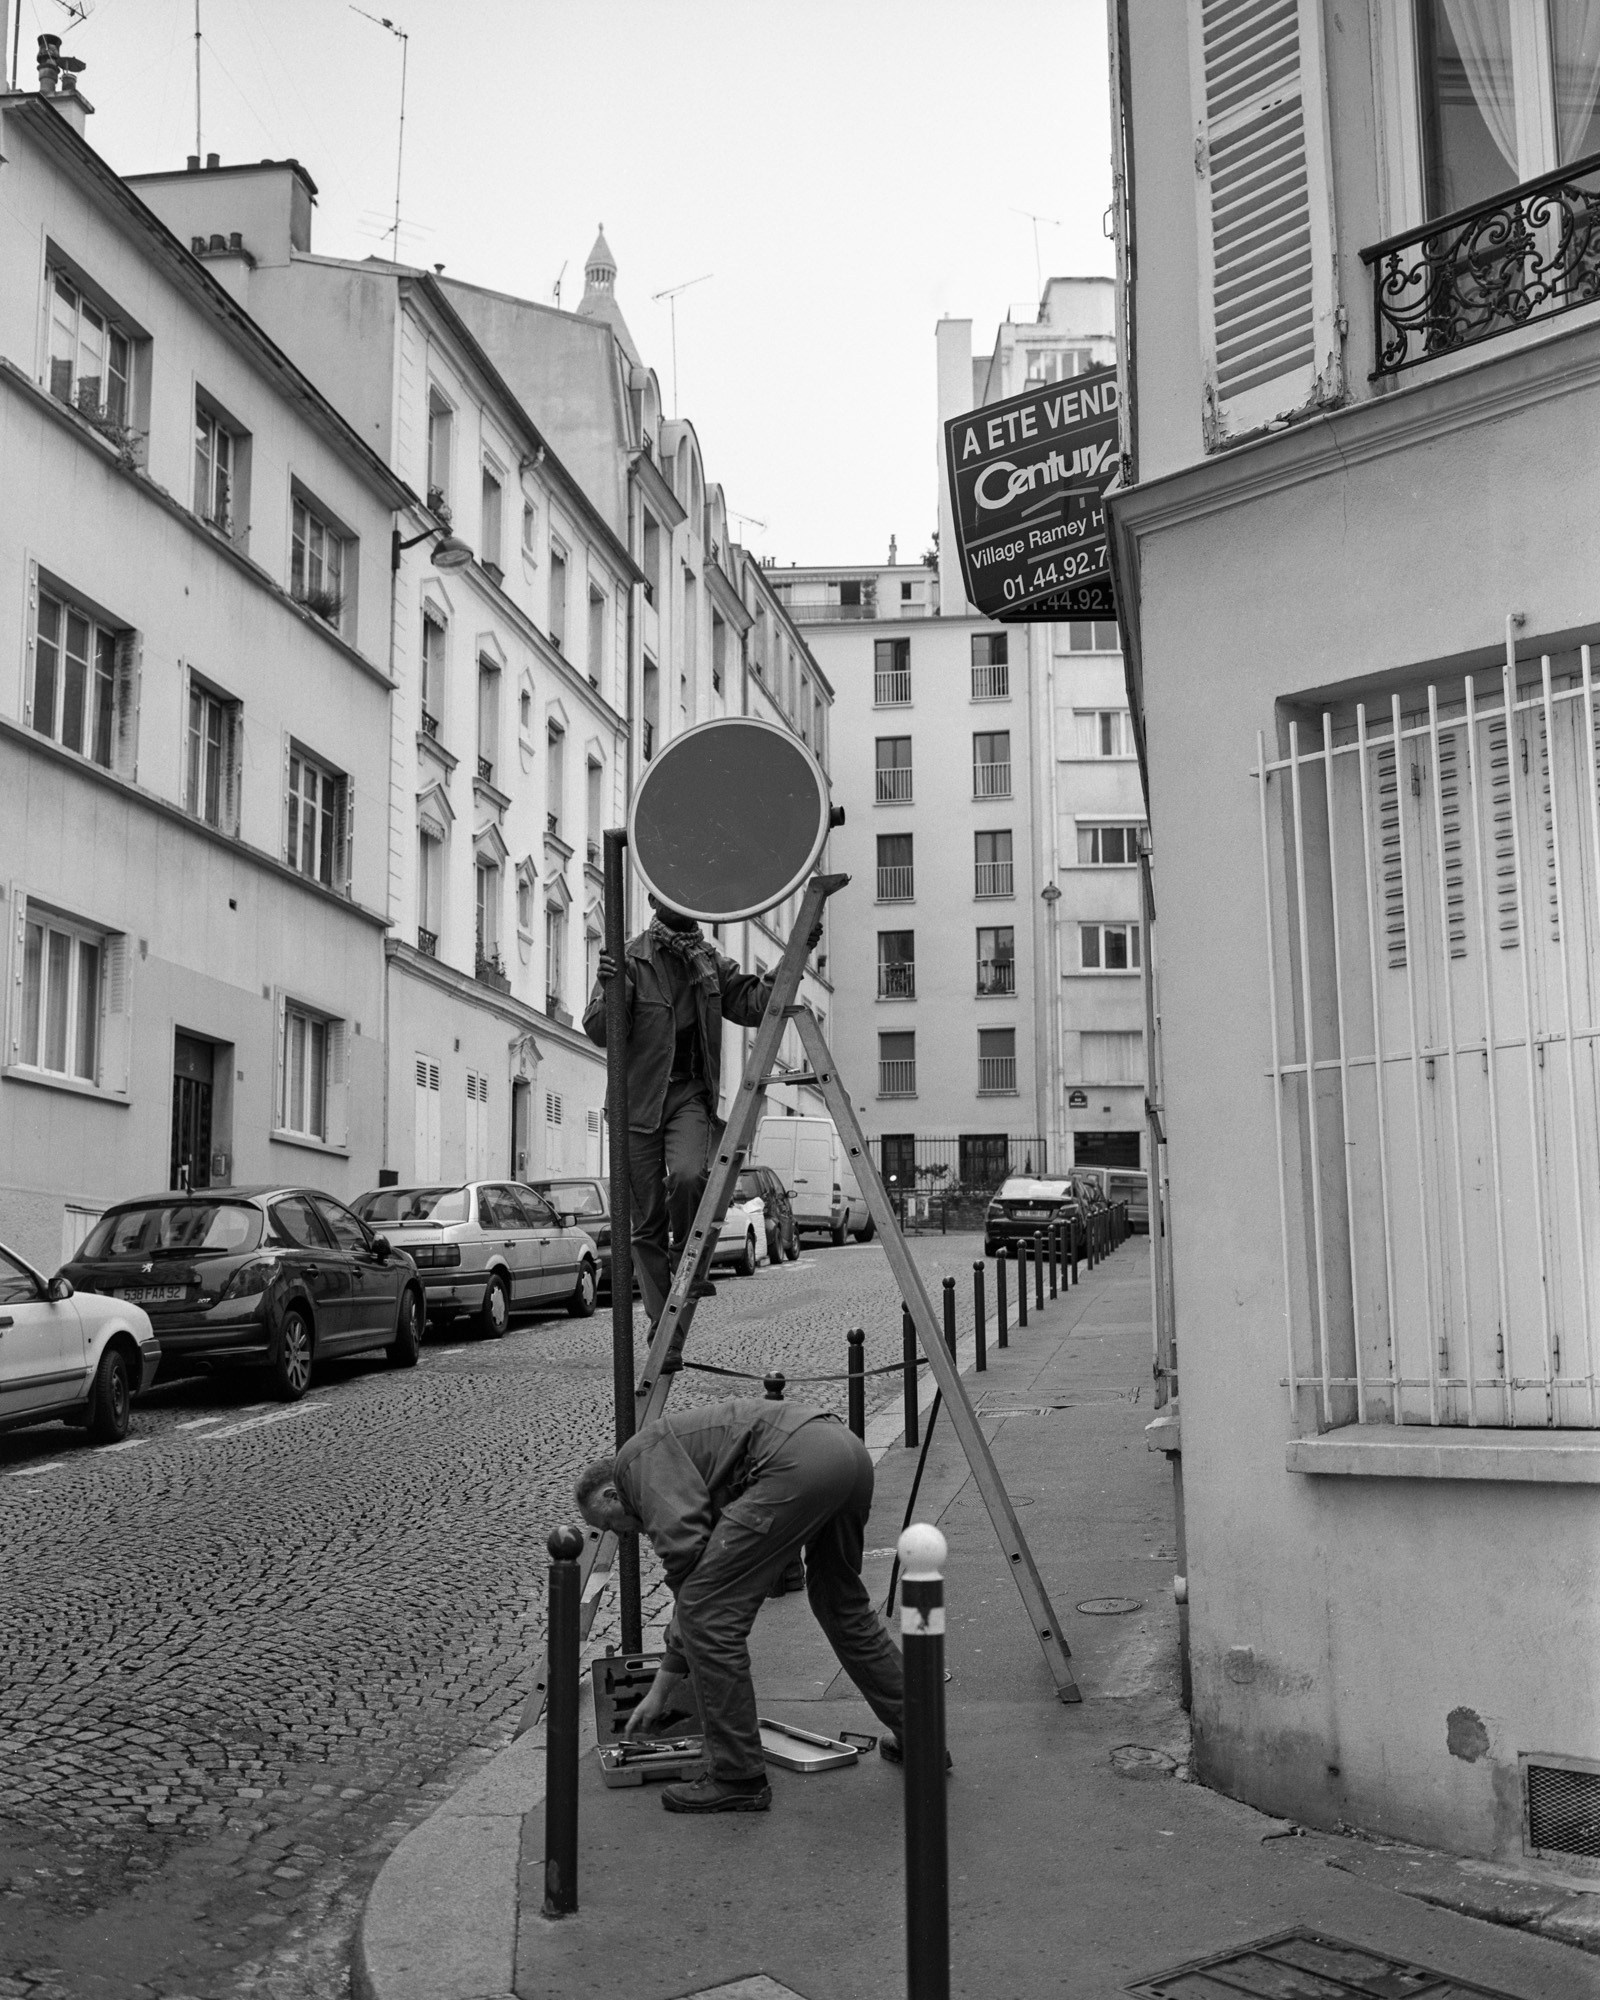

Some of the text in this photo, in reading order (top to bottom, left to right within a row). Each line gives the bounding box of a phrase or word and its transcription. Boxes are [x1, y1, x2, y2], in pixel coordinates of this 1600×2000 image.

[963, 427, 982, 460] A
[986, 405, 1039, 451] ETE
[974, 438, 1113, 510] Century
[971, 539, 1025, 569] Village
[1028, 517, 1087, 549] Ramey
[145, 1287, 165, 1300] FAA
[166, 1286, 181, 1299] 92
